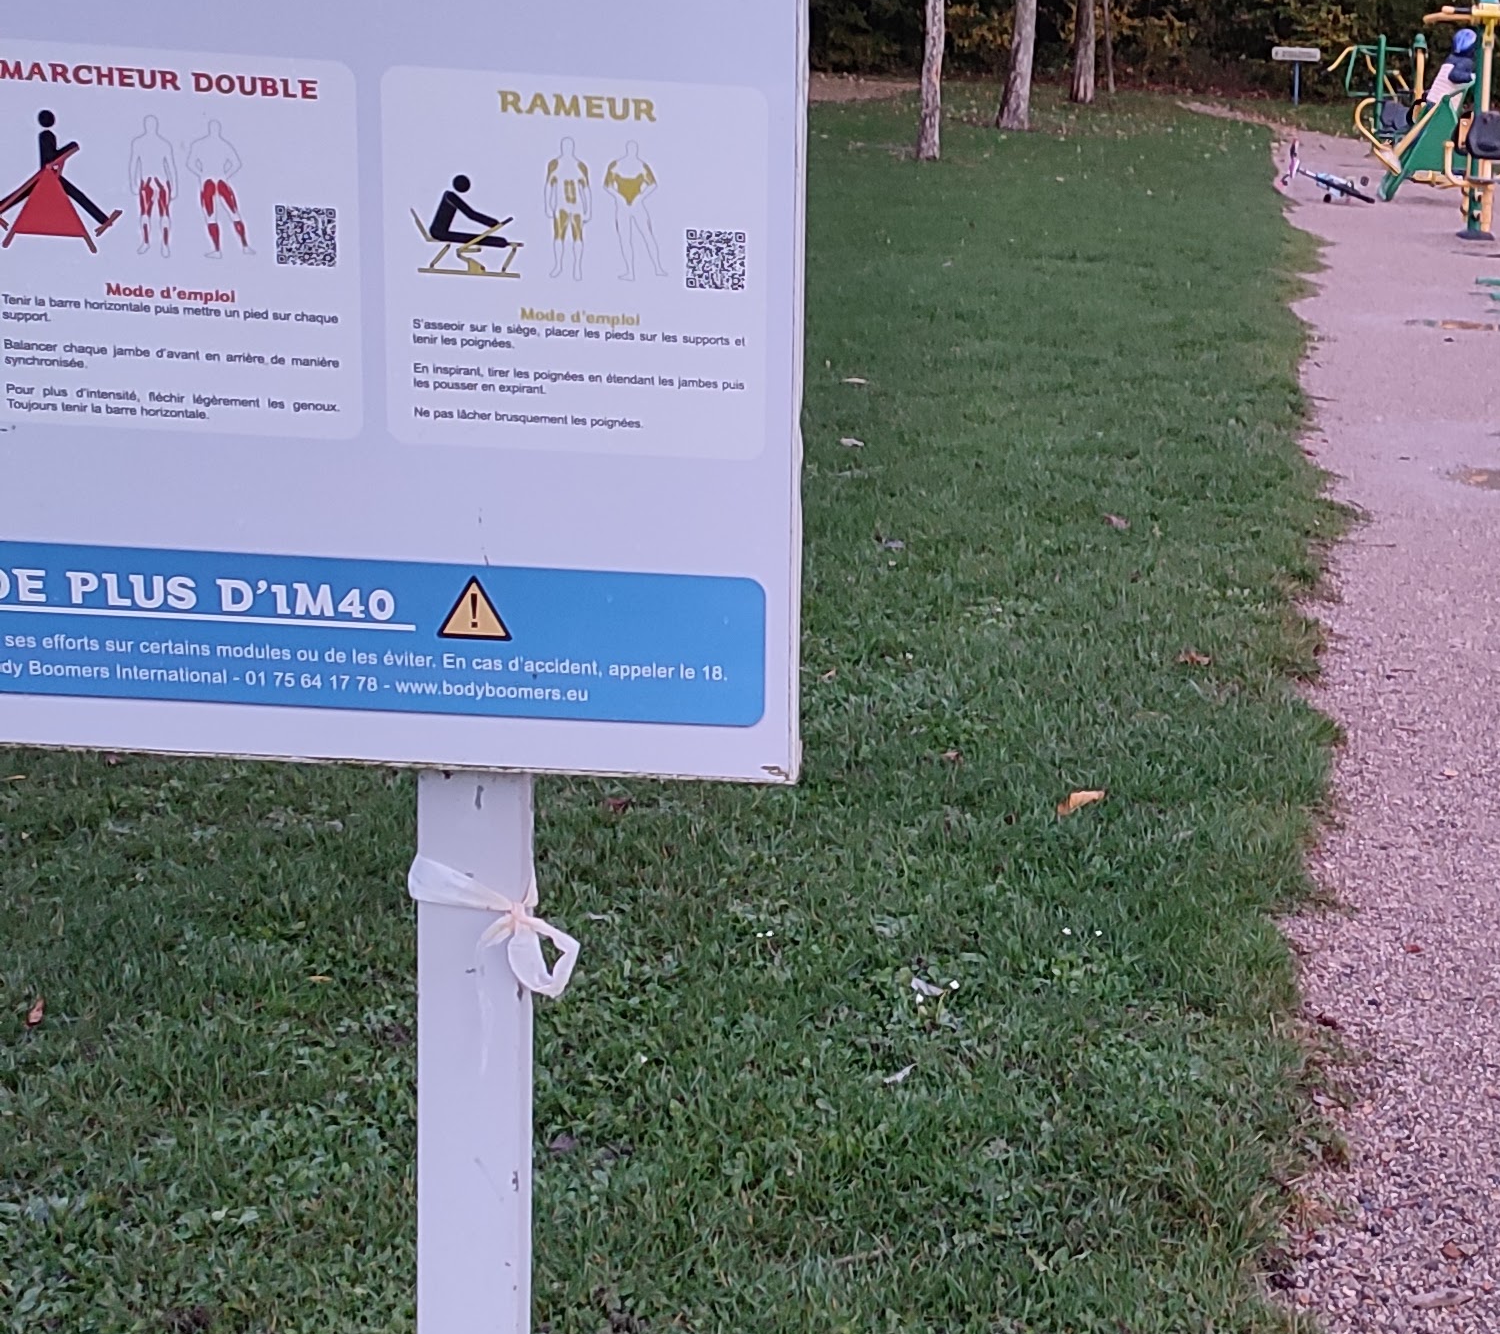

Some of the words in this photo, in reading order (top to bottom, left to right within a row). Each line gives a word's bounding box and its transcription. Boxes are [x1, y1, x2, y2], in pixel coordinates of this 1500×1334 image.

[0, 59, 181, 91] MARCHEUR
[191, 72, 318, 100] DOUBLE
[497, 90, 657, 123] RAMEUR
[105, 282, 154, 298] Mode
[159, 286, 235, 305] d'emploi
[1, 293, 31, 305] Tenir
[34, 295, 45, 307] la
[48, 296, 81, 309] barre
[83, 298, 151, 313] horizontale
[154, 303, 179, 316] puis
[182, 303, 221, 317] mettre
[224, 309, 240, 318] un
[243, 308, 269, 321] pied
[272, 311, 291, 321] sur
[294, 311, 338, 325] chaque
[2, 311, 51, 323] support.
[520, 306, 565, 322] Mode
[570, 310, 640, 329] d'emploi
[412, 318, 465, 331] S'asseoir
[469, 323, 488, 332] sur
[491, 322, 502, 334] le
[506, 323, 540, 337] siège,
[544, 326, 580, 338] placer
[583, 327, 600, 339] les
[604, 326, 635, 341] pieds
[639, 332, 657, 341] sur
[661, 331, 677, 343] les
[682, 335, 730, 346] supports
[734, 336, 745, 347] et
[412, 332, 438, 344] tenir
[440, 334, 457, 346] les
[460, 336, 515, 350] poignées.
[3, 338, 58, 352] Balancer
[62, 342, 107, 356] chaque
[112, 344, 150, 358] jambe
[155, 347, 200, 361] d'avant
[204, 352, 220, 361] en
[225, 352, 265, 364] arrière
[270, 354, 285, 365] de
[291, 356, 339, 368] manière
[4, 355, 87, 368] synchronisée.
[413, 362, 429, 374] En
[432, 363, 484, 377] inspirant,
[487, 367, 510, 378] tirer
[513, 367, 530, 379] les
[533, 370, 584, 383] poignées
[587, 374, 602, 383] en
[605, 372, 654, 385] étendant
[658, 375, 674, 386] les
[677, 376, 718, 389] jambes
[721, 381, 744, 391] puis
[413, 377, 430, 388] les
[432, 380, 478, 391] pousser
[480, 383, 495, 392] en
[5, 382, 35, 396] Pour
[42, 385, 68, 398] plus
[75, 387, 140, 403] d'intensité,
[148, 391, 185, 403] fléchir
[192, 393, 260, 408] légèrement
[267, 397, 285, 409] les
[292, 401, 340, 412] genoux.
[5, 397, 58, 412] Toujours
[60, 401, 88, 412] tenir
[90, 402, 102, 414] la
[104, 403, 137, 416] barre
[140, 405, 209, 419] horizontale.
[413, 406, 430, 418] Ne
[433, 409, 454, 420] pas
[456, 408, 492, 420] lâcher
[494, 410, 568, 425] brusquement
[570, 414, 587, 426] les
[590, 417, 643, 430] poignées.
[66, 571, 197, 610] PLUS
[216, 578, 395, 621] D'1M40
[4, 635, 36, 648] ses
[42, 633, 99, 651] efforts
[105, 639, 133, 652] sur
[139, 639, 210, 656] certains
[216, 643, 291, 660] modules
[296, 649, 318, 661] ou
[324, 647, 346, 663] de
[352, 648, 377, 664] les
[383, 650, 436, 667] éviter.
[442, 653, 466, 669] En
[471, 658, 502, 671] cas
[508, 656, 602, 677] d'accident,
[608, 661, 675, 680] appeler
[679, 662, 695, 679] le
[702, 664, 727, 681] 18.
[28, 659, 109, 678] Boomers
[116, 663, 227, 684] International
[245, 670, 265, 686] 01
[273, 671, 295, 687] 75
[300, 673, 322, 689] 64
[329, 674, 350, 690] 17
[355, 675, 377, 691] 78
[395, 679, 588, 701] www.bodyboomers.eu
